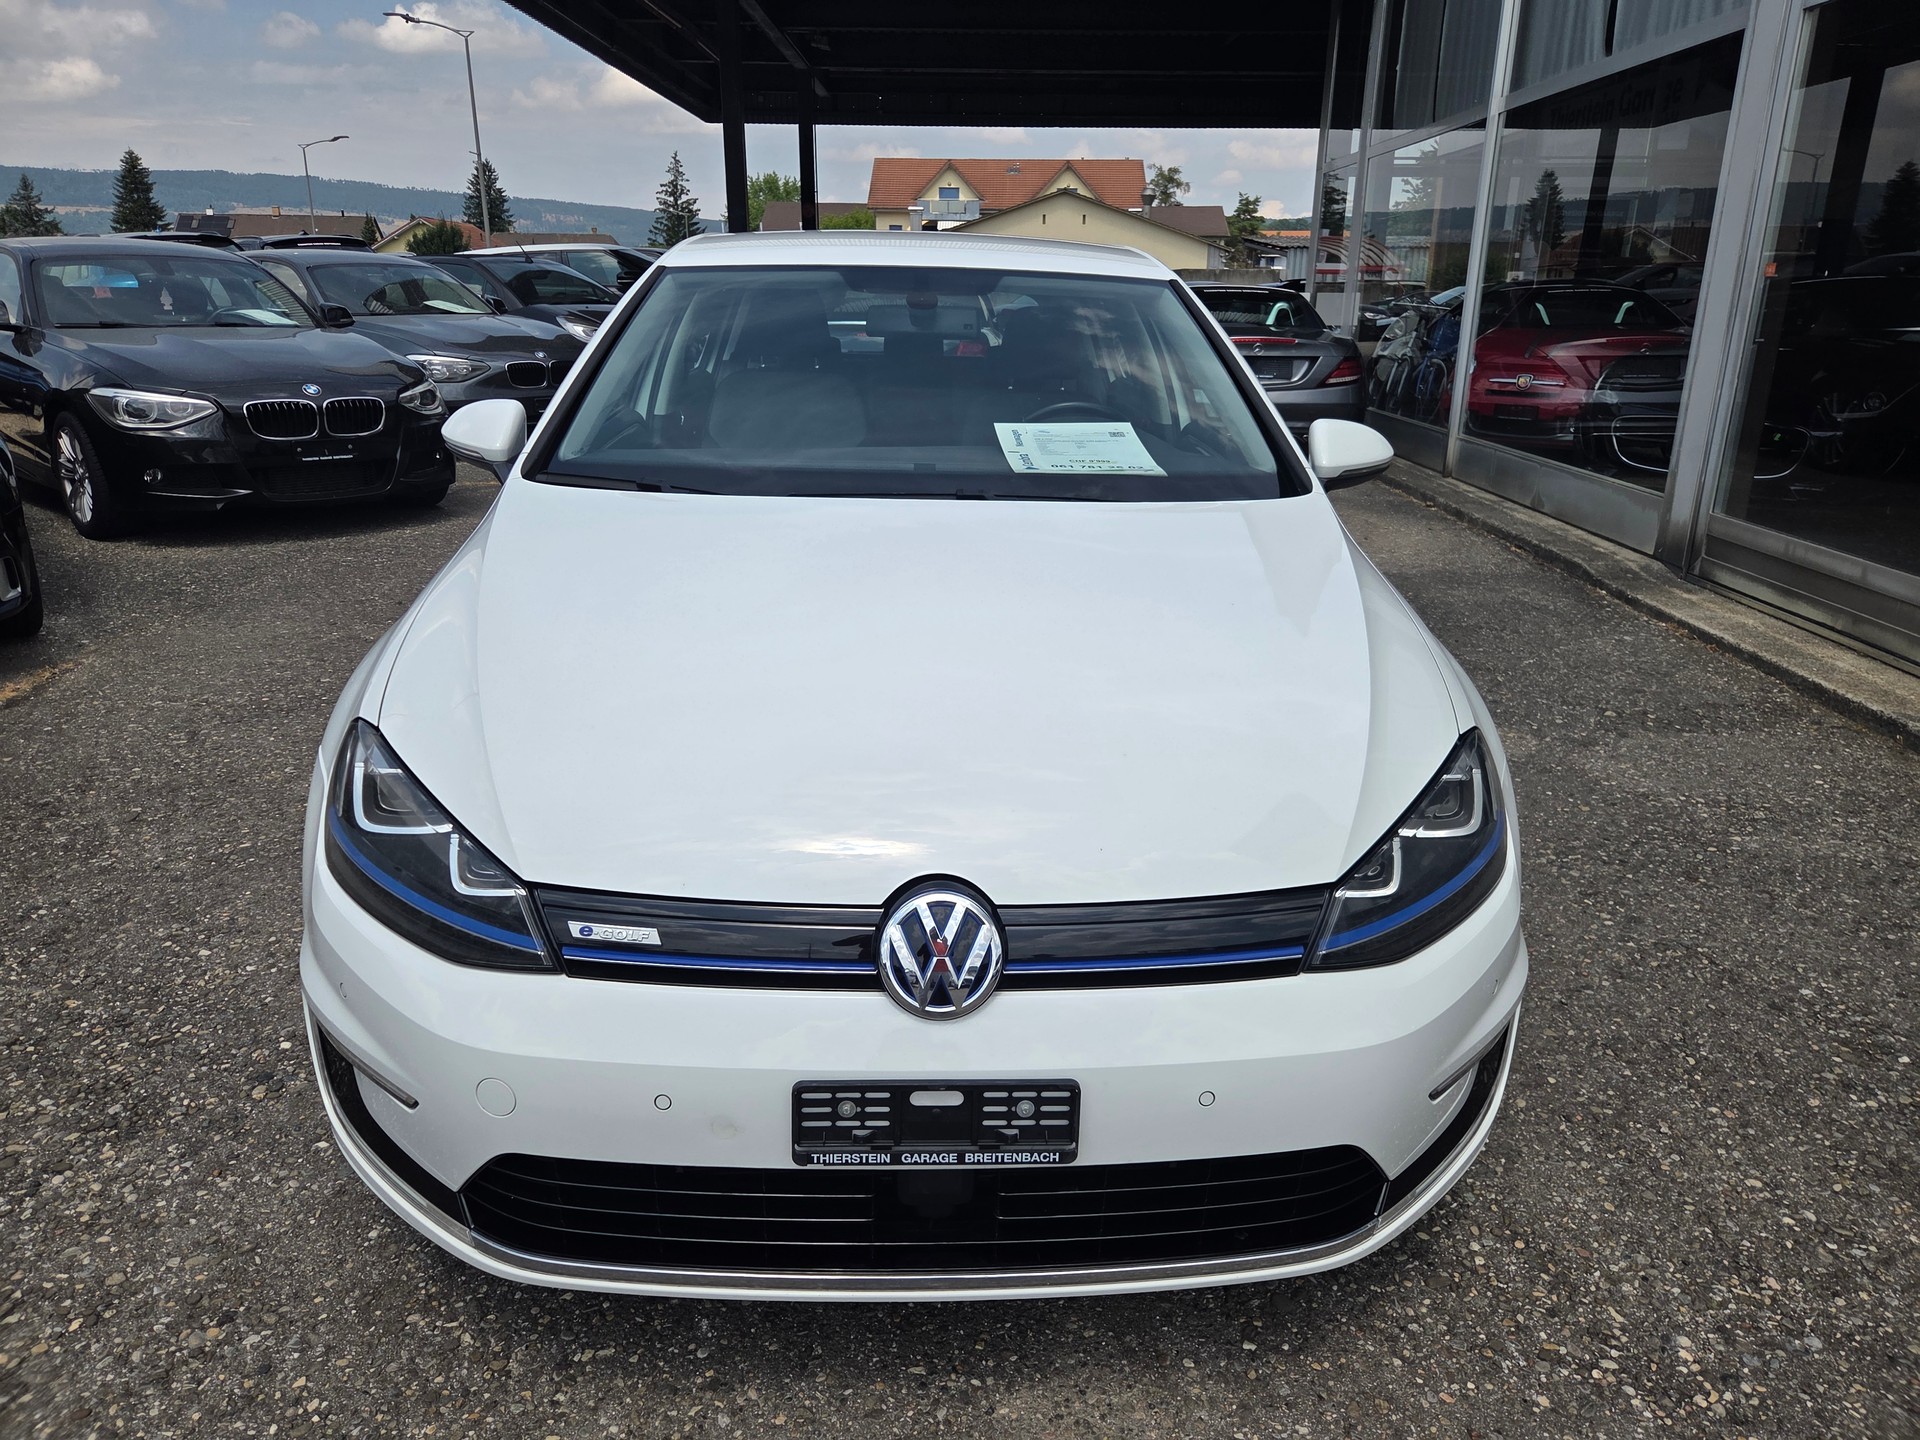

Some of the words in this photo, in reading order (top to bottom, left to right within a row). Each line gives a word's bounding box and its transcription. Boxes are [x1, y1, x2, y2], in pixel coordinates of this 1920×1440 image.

[579, 925, 650, 942] e-GOLF
[811, 1153, 891, 1164] THIERSTEIN
[901, 1153, 958, 1164] GARAGE
[964, 1152, 1060, 1164] BREITENBACH
